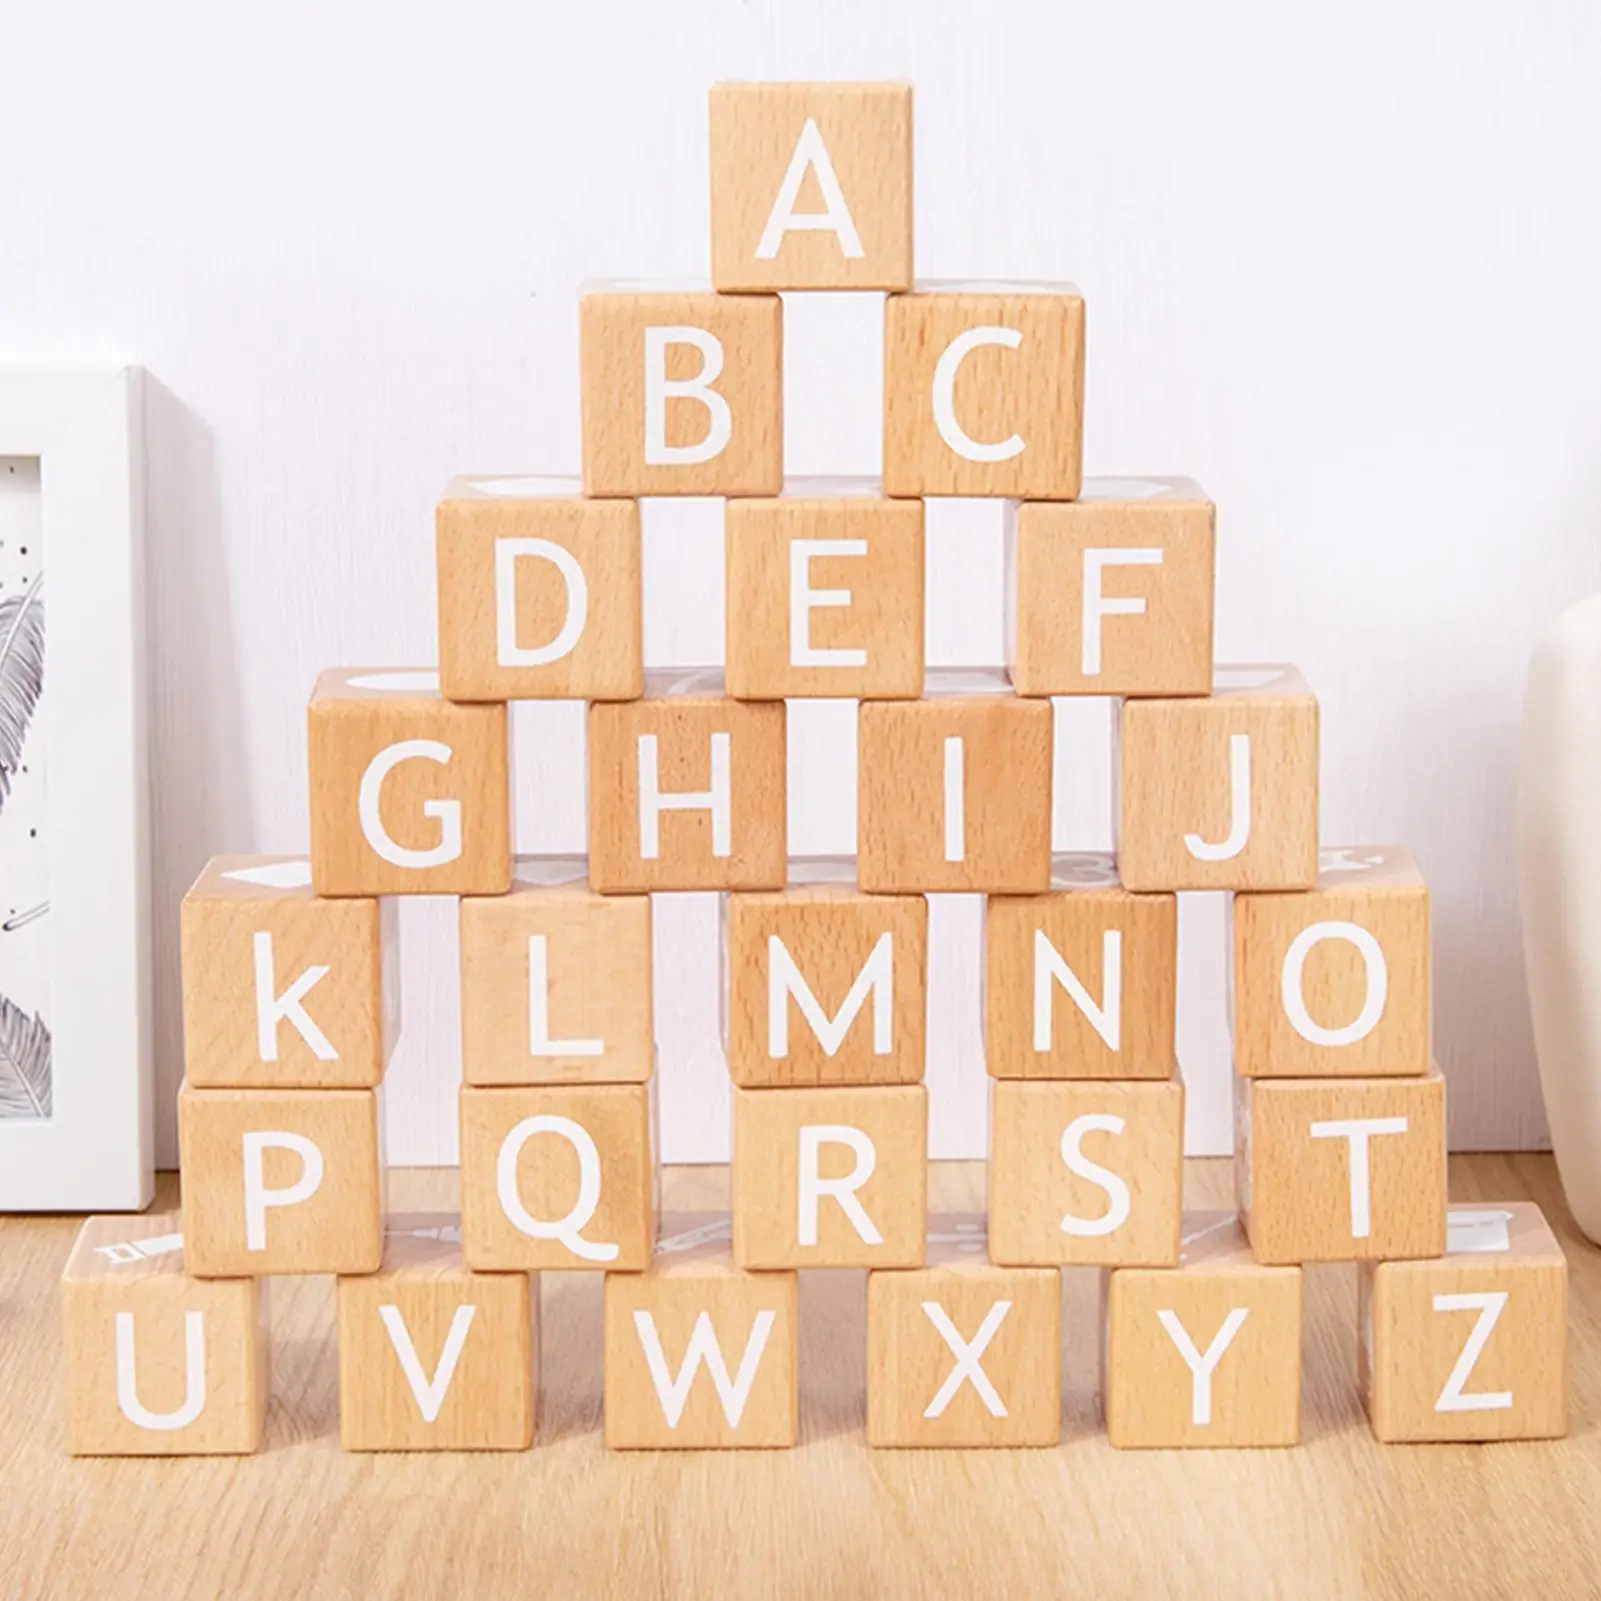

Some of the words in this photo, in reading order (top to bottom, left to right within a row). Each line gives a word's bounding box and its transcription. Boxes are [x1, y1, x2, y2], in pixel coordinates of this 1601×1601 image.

[755, 119, 864, 259] A
[645, 326, 731, 464] B
[933, 327, 1024, 461] C
[495, 538, 587, 666] D
[790, 539, 867, 666] E
[1083, 548, 1164, 676] F
[359, 740, 461, 868] G
[639, 733, 730, 858] H
[945, 737, 964, 861] I
[1184, 735, 1251, 861] J
[529, 935, 604, 1056] L
[769, 933, 892, 1058] M
[1035, 930, 1121, 1051] N
[1283, 921, 1387, 1046] O
[243, 1132, 323, 1250] P
[497, 1116, 618, 1261] Q
[799, 1125, 883, 1245] R
[1061, 1115, 1130, 1236] S
[1312, 1118, 1407, 1237] T
[115, 1311, 205, 1430] U
[380, 1306, 474, 1421] V
[635, 1311, 775, 1428] W
[922, 1301, 1012, 1418] X
[1158, 1309, 1247, 1424] Y
[1434, 1293, 1512, 1411] Z
